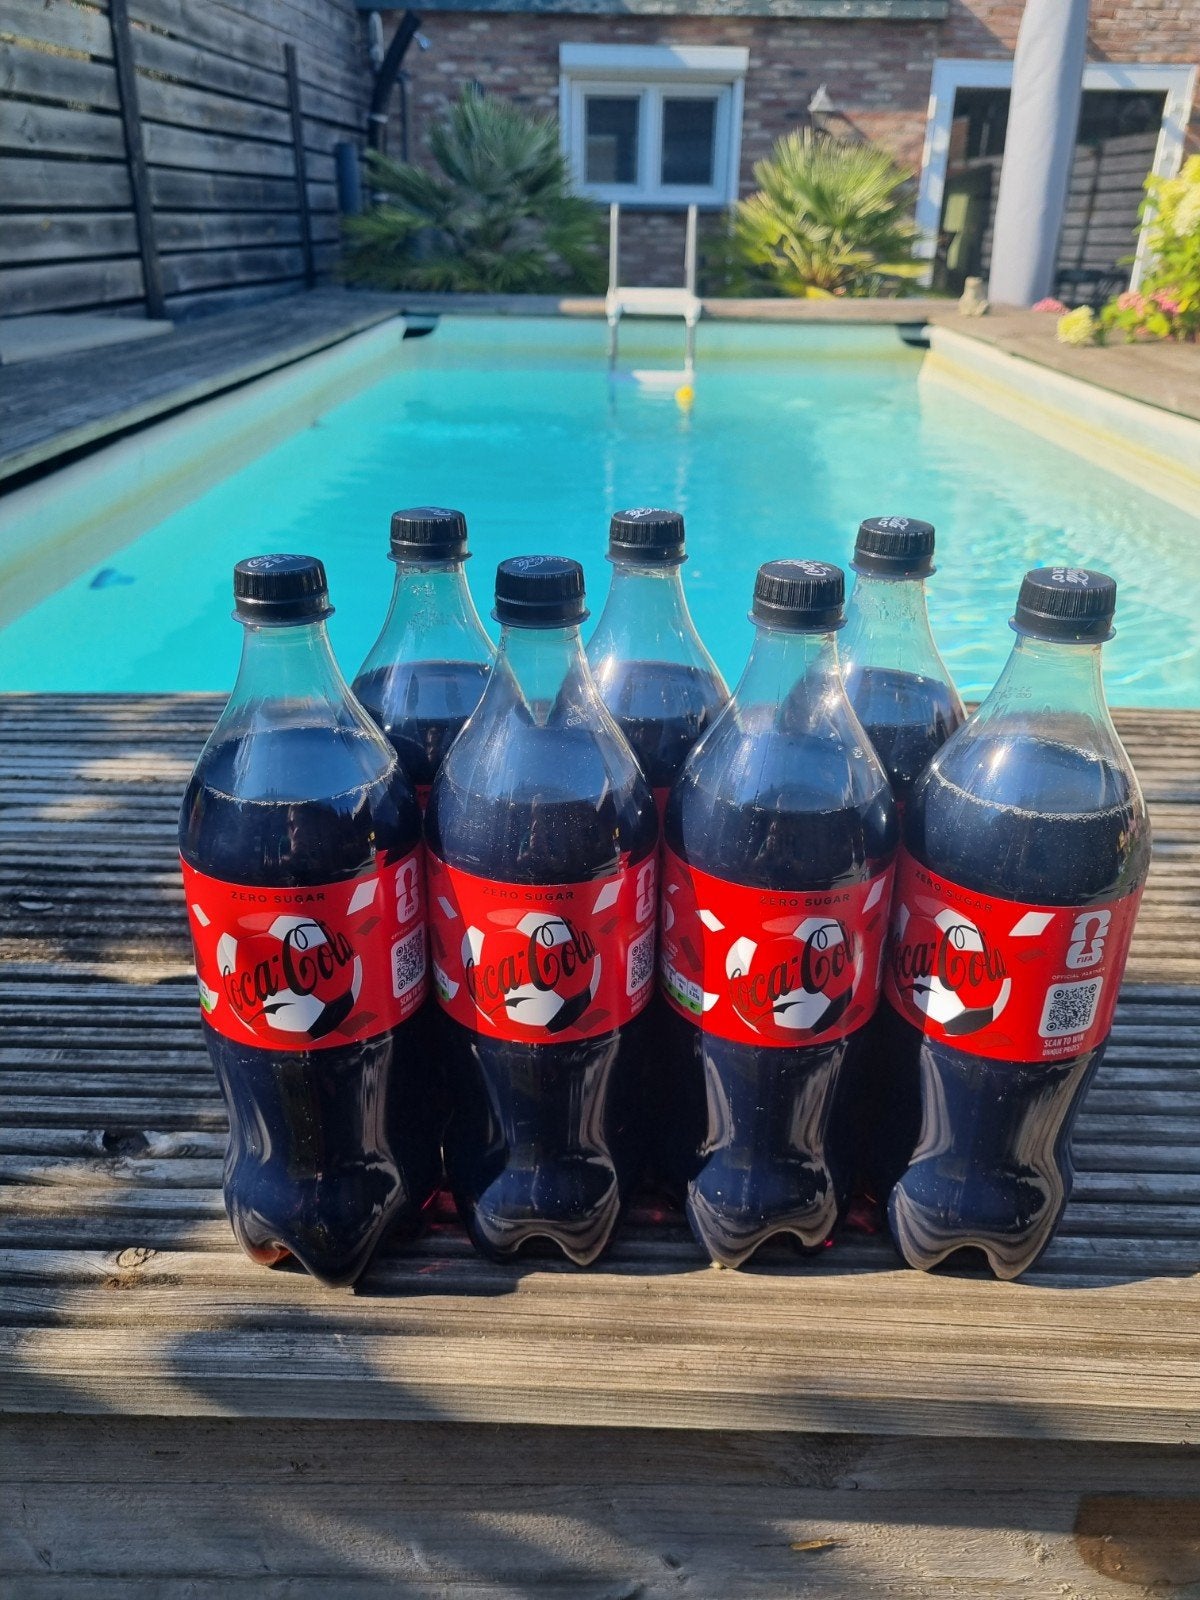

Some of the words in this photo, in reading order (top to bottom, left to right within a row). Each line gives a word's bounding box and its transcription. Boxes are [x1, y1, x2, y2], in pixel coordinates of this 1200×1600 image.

[231, 890, 268, 903] ZERO
[273, 892, 326, 904] SUGAR
[481, 886, 519, 899] ZERO
[524, 891, 575, 901] SUGAR
[916, 870, 942, 892] ZERO
[945, 889, 993, 912] SUGAR
[760, 895, 799, 907] ZERO
[804, 893, 850, 907] SUGAR
[465, 916, 598, 1016] Coca-Cola
[1076, 955, 1093, 964] FIFA
[222, 919, 356, 1024] Coca-Cola
[1043, 1038, 1062, 1048] SCAN
[1063, 1035, 1072, 1045] TO
[1072, 1032, 1085, 1044] WIN
